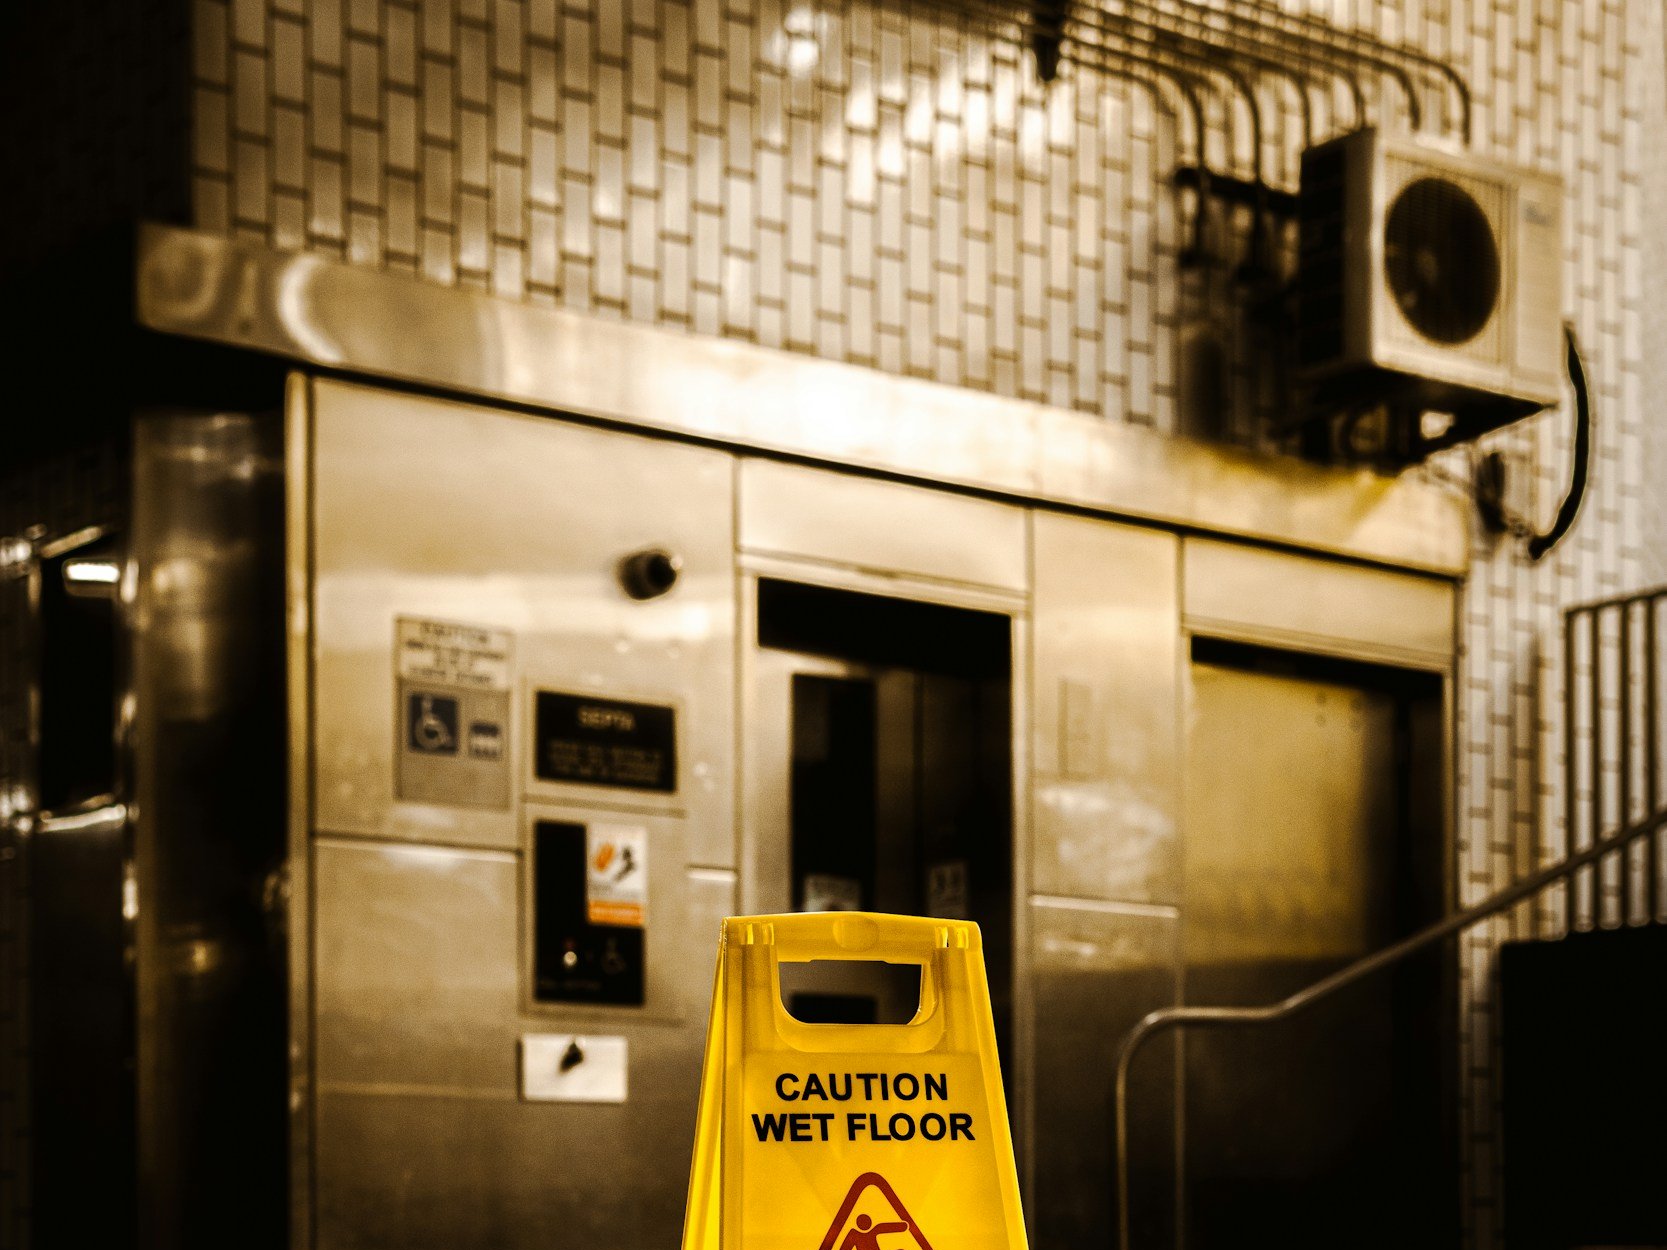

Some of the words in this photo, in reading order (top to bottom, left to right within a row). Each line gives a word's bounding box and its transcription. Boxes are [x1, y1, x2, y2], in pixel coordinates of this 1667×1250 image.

[775, 1072, 949, 1102] CAUTION
[751, 1112, 835, 1142] WET
[846, 1111, 976, 1142] FLOOR
